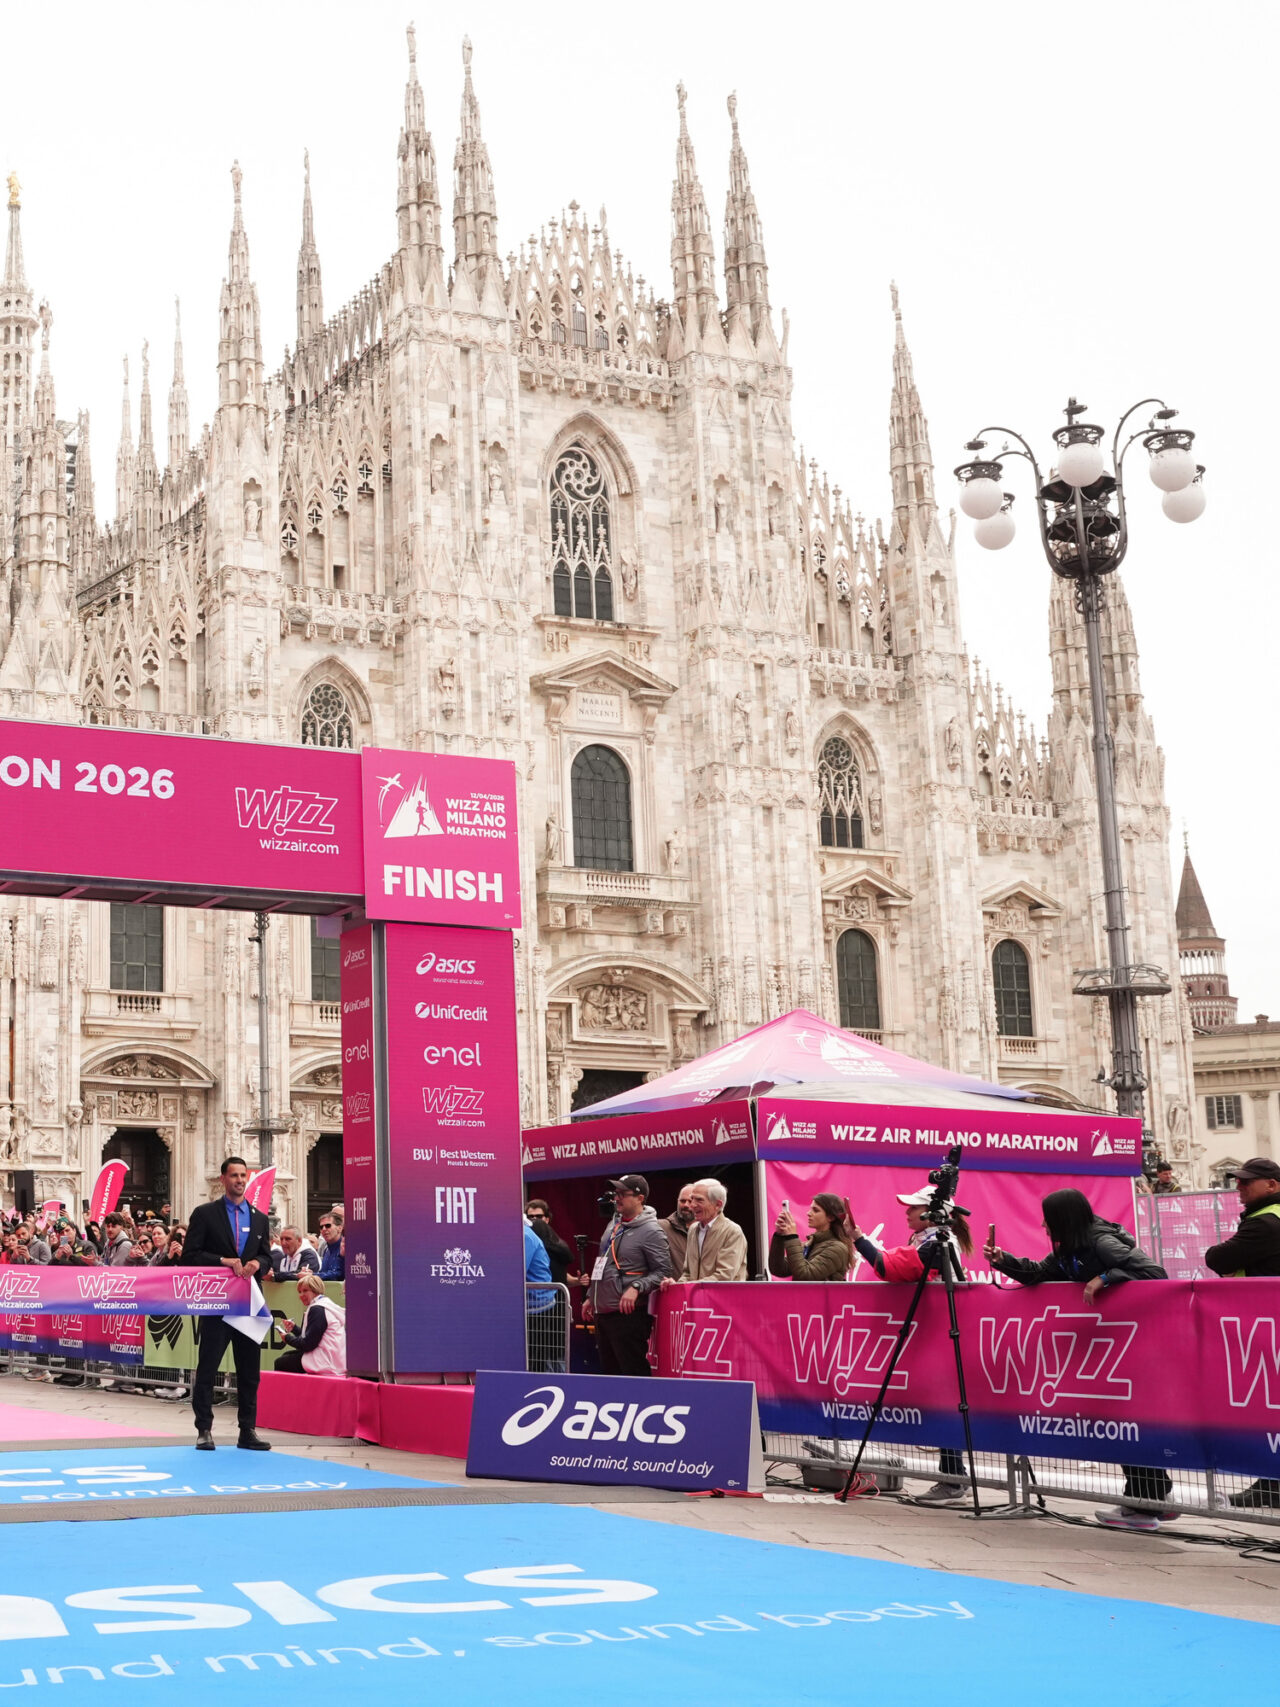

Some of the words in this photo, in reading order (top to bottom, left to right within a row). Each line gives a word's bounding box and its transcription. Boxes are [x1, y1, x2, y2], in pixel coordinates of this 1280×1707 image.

[74, 762, 175, 799] 2026
[446, 798, 480, 811] WIZZ
[483, 802, 505, 813] AIR
[446, 812, 506, 827] MILANO
[447, 826, 506, 839] MARATHON
[260, 838, 339, 854] wizzair.com
[383, 865, 504, 903] FINISH
[435, 958, 476, 974] asics
[432, 1005, 488, 1021] UniCredit
[424, 1043, 481, 1066] enel
[437, 1119, 485, 1127] wizzair.com
[552, 1144, 577, 1159] WIZZ
[580, 1142, 596, 1156] AIR
[599, 1136, 639, 1154] MILANO
[641, 1129, 704, 1150] MARATHON
[831, 1124, 876, 1142] WIZZ
[881, 1128, 910, 1144] AIR
[916, 1129, 982, 1147] MILANO
[986, 1134, 1078, 1152] MARATHON
[413, 1149, 433, 1161] BW
[440, 1150, 459, 1159] Best
[102, 1171, 114, 1216] MARATHON
[353, 1198, 367, 1221] FIAT
[435, 1187, 477, 1223] FIAT
[431, 1265, 485, 1277] FESTINA
[93, 1302, 138, 1310] wizzair.com
[187, 1302, 230, 1310] wizzair.com
[562, 1401, 690, 1444] asics
[1019, 1410, 1139, 1442] wizzair.com
[550, 1453, 592, 1468] sound
[593, 1455, 629, 1471] mind,
[632, 1457, 675, 1473] sound
[677, 1458, 714, 1479] body
[20, 1485, 196, 1500] sound
[210, 1480, 347, 1495] body
[205, 1637, 466, 1672] mind,
[482, 1615, 758, 1648] sound
[759, 1600, 976, 1629] body
